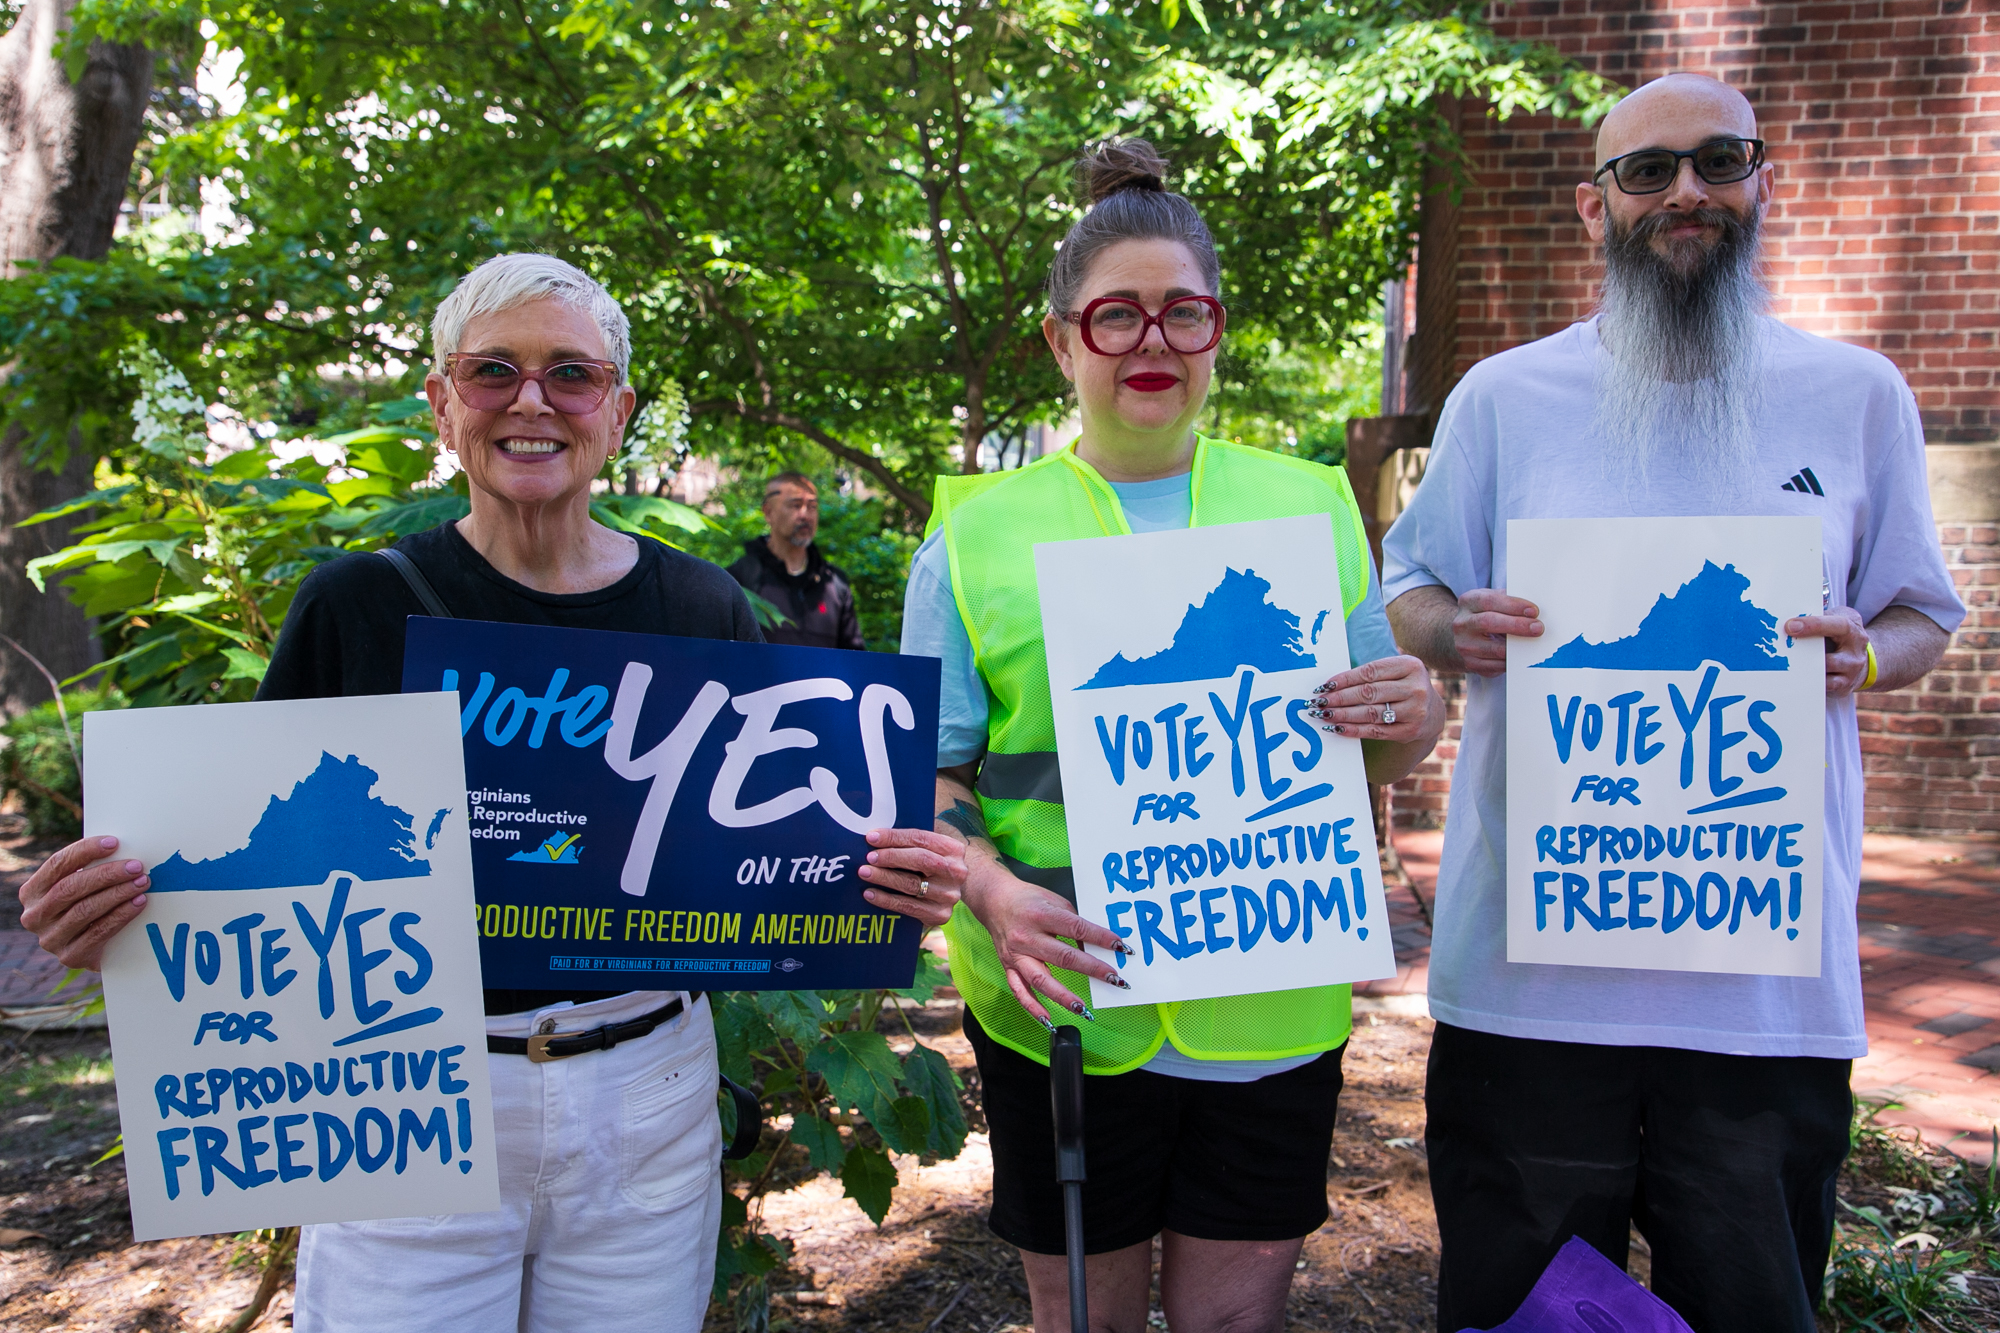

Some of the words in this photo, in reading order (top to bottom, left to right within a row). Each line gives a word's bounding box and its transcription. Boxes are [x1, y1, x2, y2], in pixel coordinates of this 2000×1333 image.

[1095, 703, 1214, 786] VOTE
[1208, 671, 1323, 801] YES
[1547, 690, 1665, 766] VOTE
[1668, 666, 1783, 798] YES
[442, 668, 613, 749] Vote
[604, 661, 915, 897] YES
[466, 787, 531, 805] rginians
[1572, 775, 1641, 805] FOR
[473, 806, 588, 825] Reproductive
[1133, 792, 1200, 825] FOR
[469, 825, 521, 840] edom
[1103, 817, 1360, 893] REPRODUCTIVE
[1536, 822, 1804, 867] REPRODUCTIVE
[737, 856, 781, 885] ON
[789, 855, 851, 883] THE
[475, 903, 615, 941] ODUCTIVE
[624, 910, 742, 944] FREEDOM
[751, 913, 901, 945] AMENDMENT
[1105, 868, 1369, 969] FREEDOM!
[1534, 870, 1803, 941] FREEDOM!
[146, 913, 297, 1002] VOTE
[292, 877, 433, 1025] YES
[553, 958, 571, 968] PAID
[575, 958, 590, 968] FOR
[594, 959, 604, 968] BY
[608, 959, 652, 969] VIRGINIANS
[656, 960, 670, 970] FOR
[674, 960, 731, 970] REPRODUCTIVE
[734, 961, 768, 971] FREEDOM
[194, 1011, 278, 1045] FOR
[155, 1045, 470, 1119] REPRODUCTIVE
[157, 1098, 473, 1200] FREEDOM!
